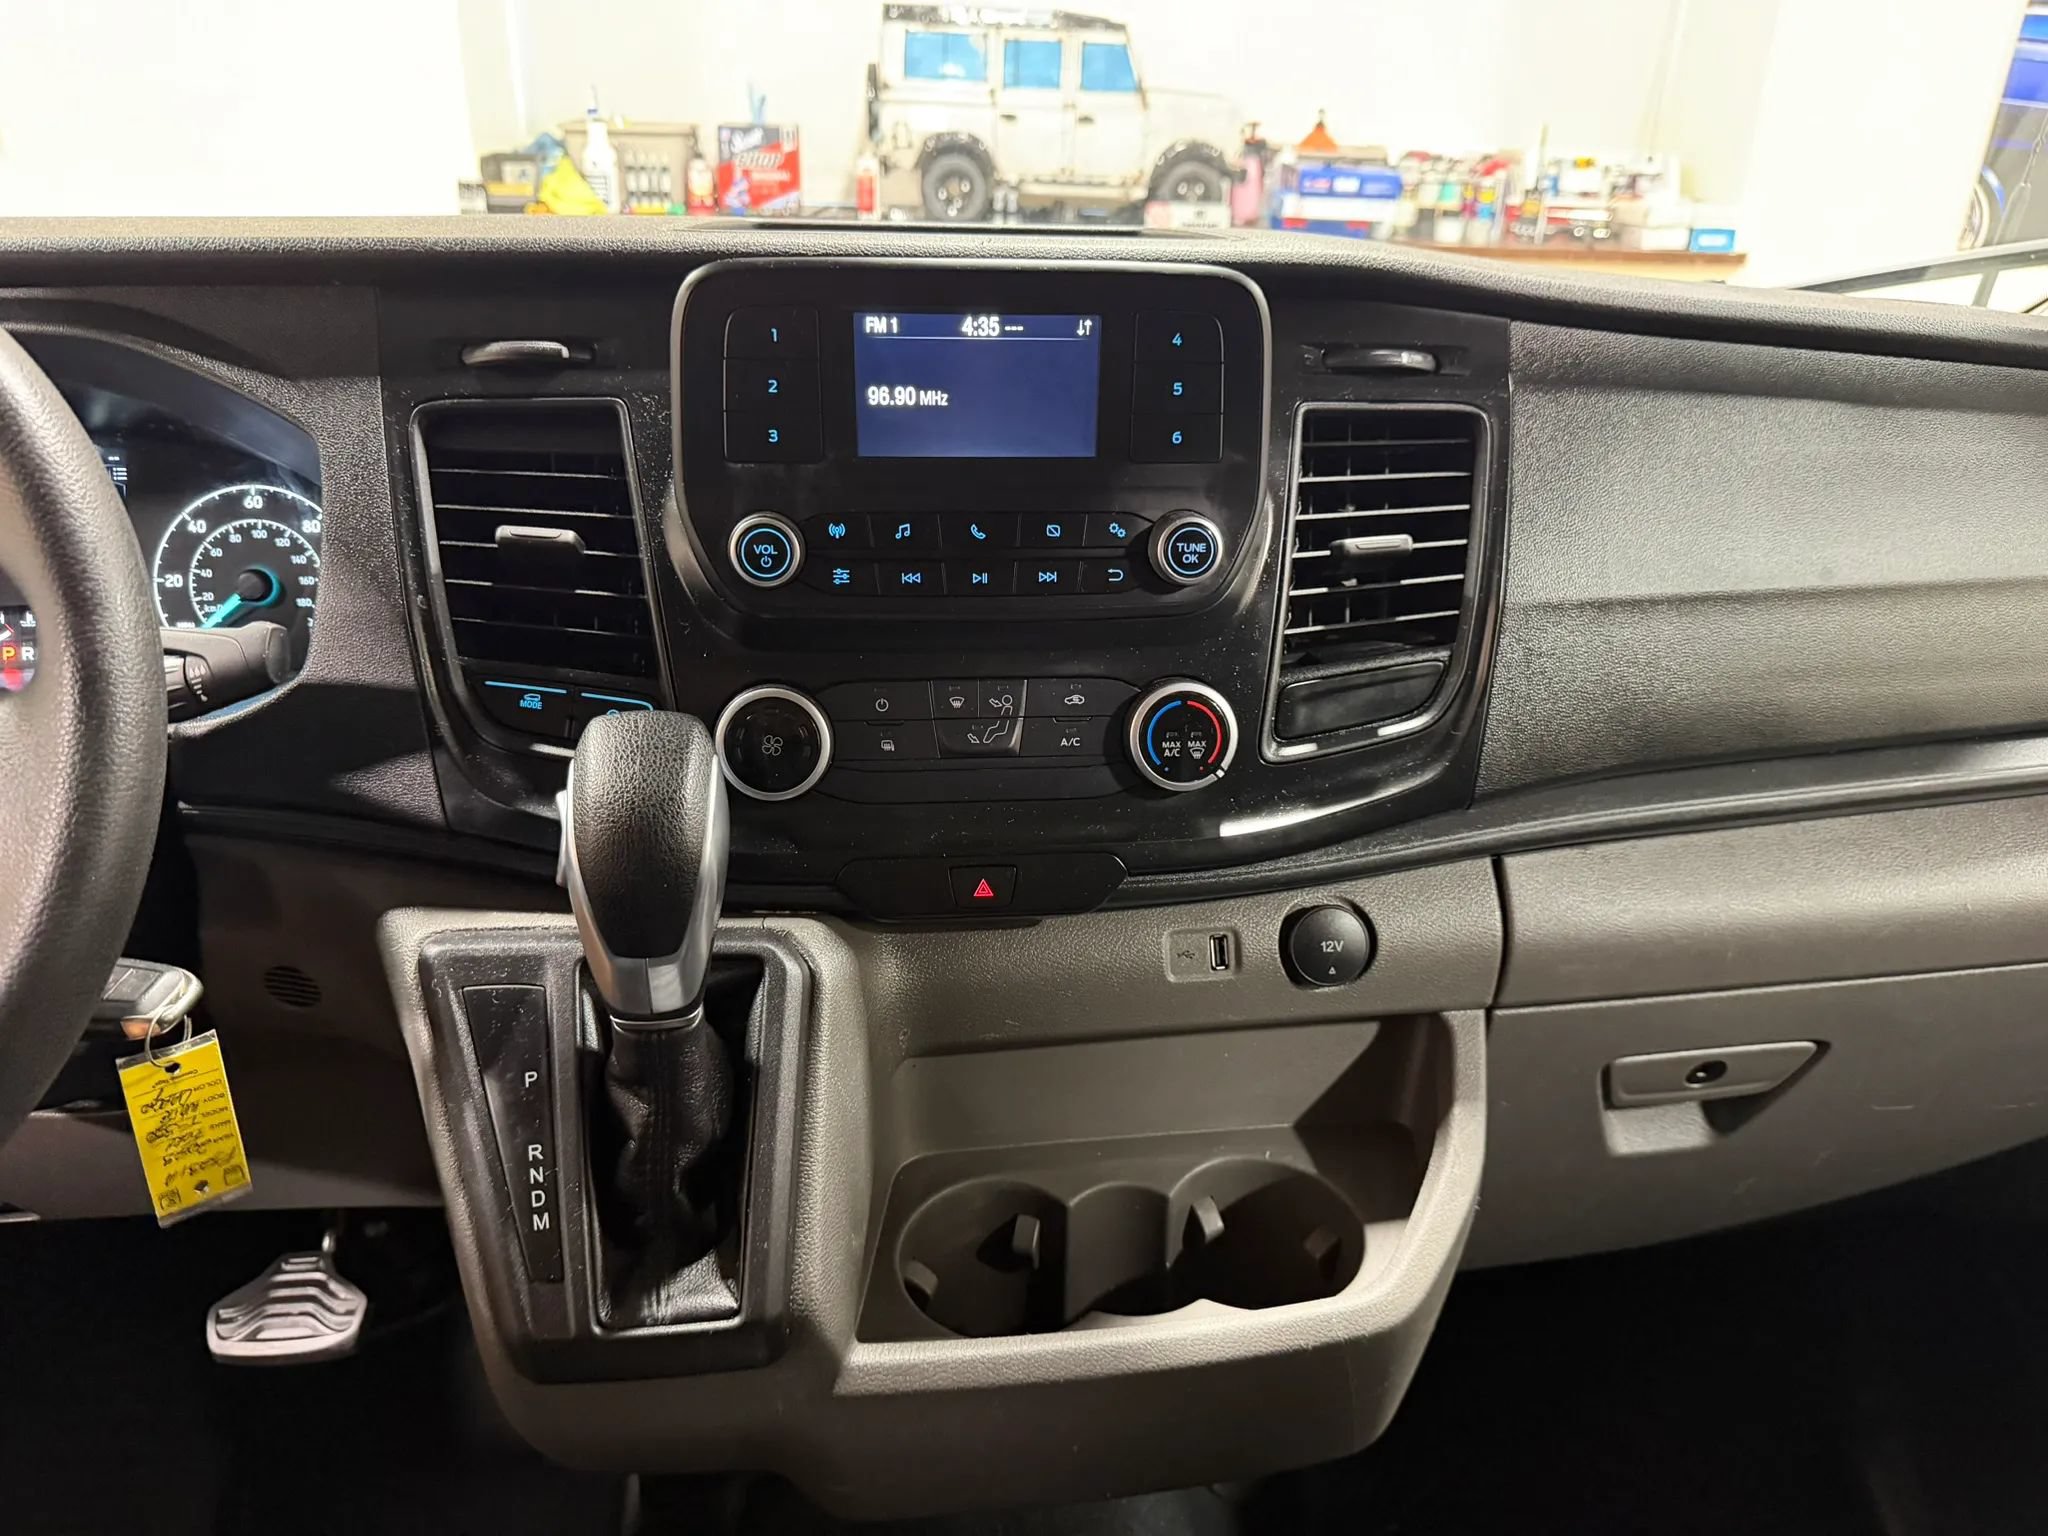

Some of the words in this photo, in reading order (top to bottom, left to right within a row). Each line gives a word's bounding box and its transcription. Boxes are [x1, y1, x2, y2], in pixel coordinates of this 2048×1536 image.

[865, 316, 887, 334] FM
[890, 316, 898, 334] 1
[961, 316, 1000, 336] 4:35
[770, 327, 778, 342] 1
[1171, 332, 1183, 346] 4
[767, 379, 778, 393] 2
[1172, 382, 1183, 396] 5
[867, 386, 917, 406] 96.90
[919, 390, 949, 406] MHz
[767, 429, 779, 443] 3
[1171, 431, 1182, 444] 6
[242, 495, 264, 509] 60
[187, 520, 206, 534] 40
[301, 519, 321, 533] 80
[228, 533, 242, 543] 80
[250, 529, 268, 540] 100
[274, 538, 291, 548] 120
[752, 544, 779, 555] VOL
[1176, 542, 1207, 553] TUNE
[209, 547, 223, 558] 60
[1182, 553, 1199, 564] OK
[290, 555, 308, 565] 140
[200, 568, 213, 579] 40
[164, 574, 184, 588] 20
[298, 576, 315, 586] 160
[201, 592, 215, 602] 20
[295, 597, 313, 607] 180
[2, 646, 17, 661] P
[21, 646, 35, 661] R
[519, 699, 542, 710] MODE
[1060, 737, 1082, 747] A/C
[1161, 741, 1182, 749] MAX
[1187, 740, 1207, 748] MAX
[1163, 748, 1181, 758] A/C
[1319, 940, 1345, 953] 12V
[524, 1071, 538, 1088] P
[528, 1144, 543, 1161] R
[529, 1167, 544, 1185] N
[531, 1190, 546, 1208] D
[533, 1212, 550, 1231] M
